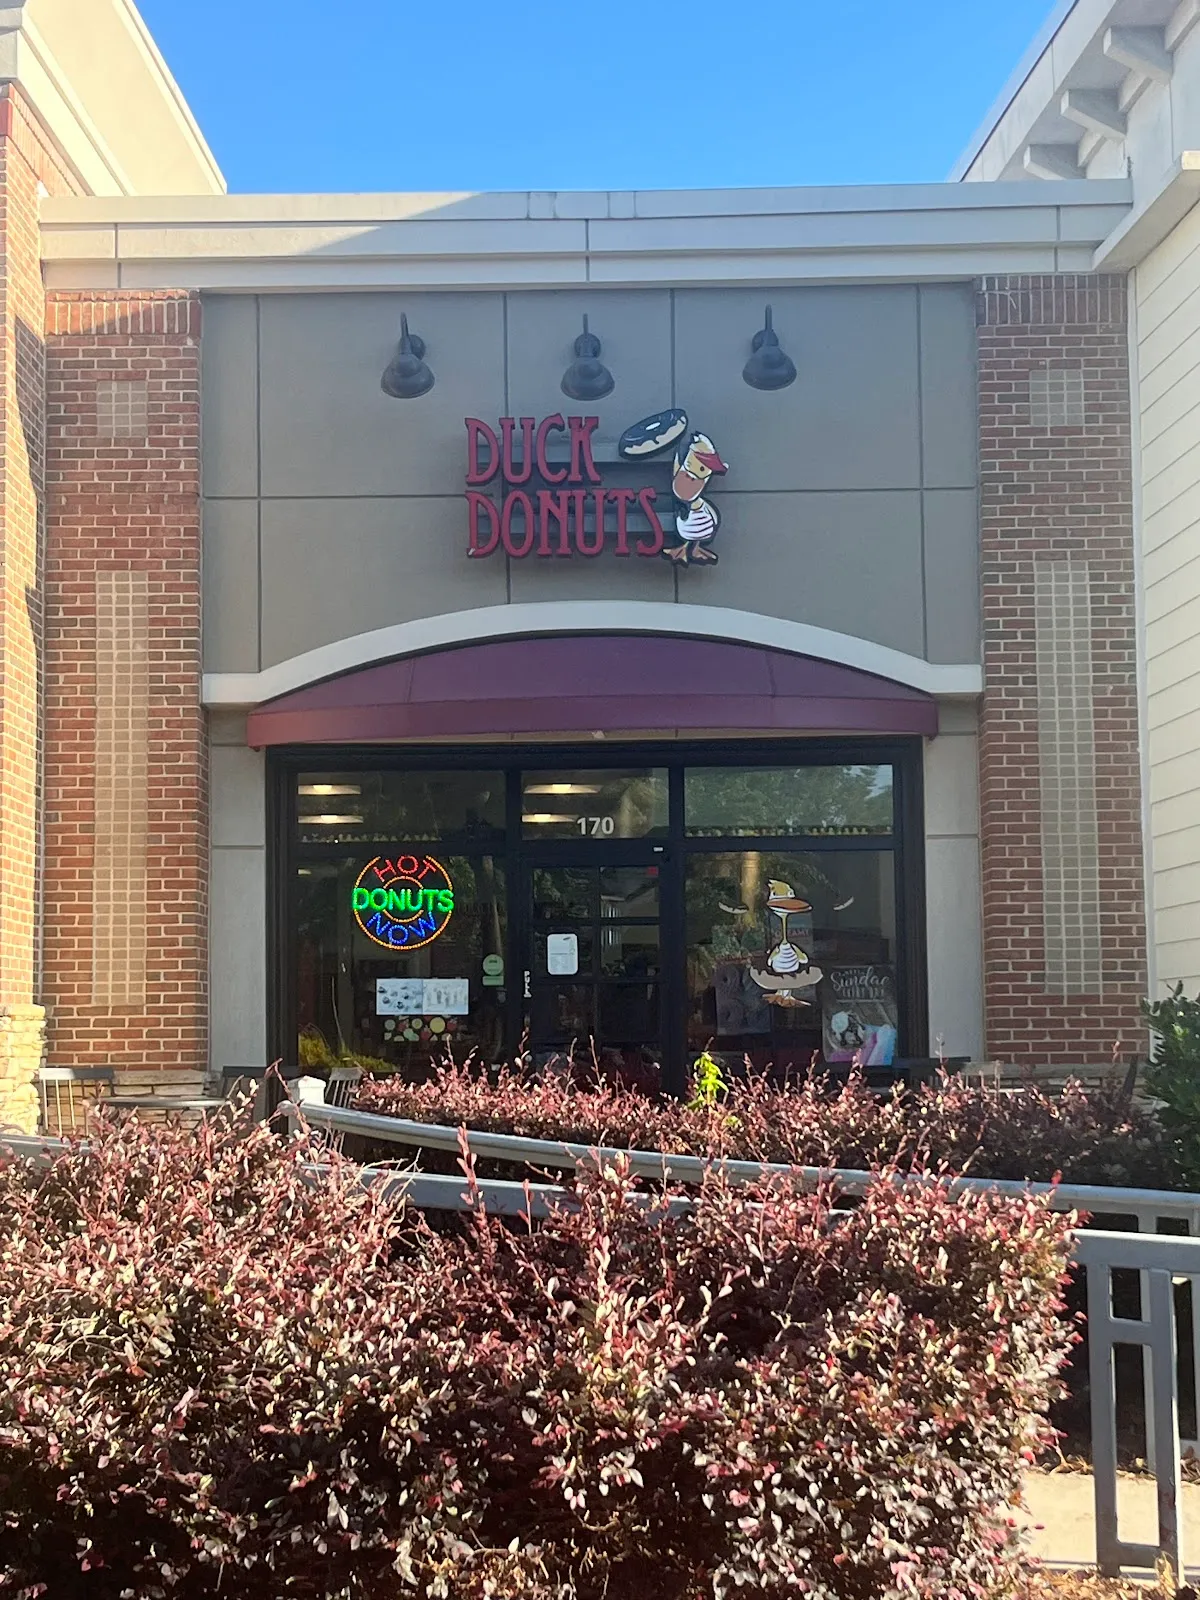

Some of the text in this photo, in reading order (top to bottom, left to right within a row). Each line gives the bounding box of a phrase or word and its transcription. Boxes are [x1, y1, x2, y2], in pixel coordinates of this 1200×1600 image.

[464, 412, 601, 485] DUCK
[464, 486, 663, 558] DONUTS
[576, 816, 615, 836] 170
[373, 854, 437, 883] HOT
[352, 888, 455, 913] DONUTS
[366, 912, 437, 945] NOW
